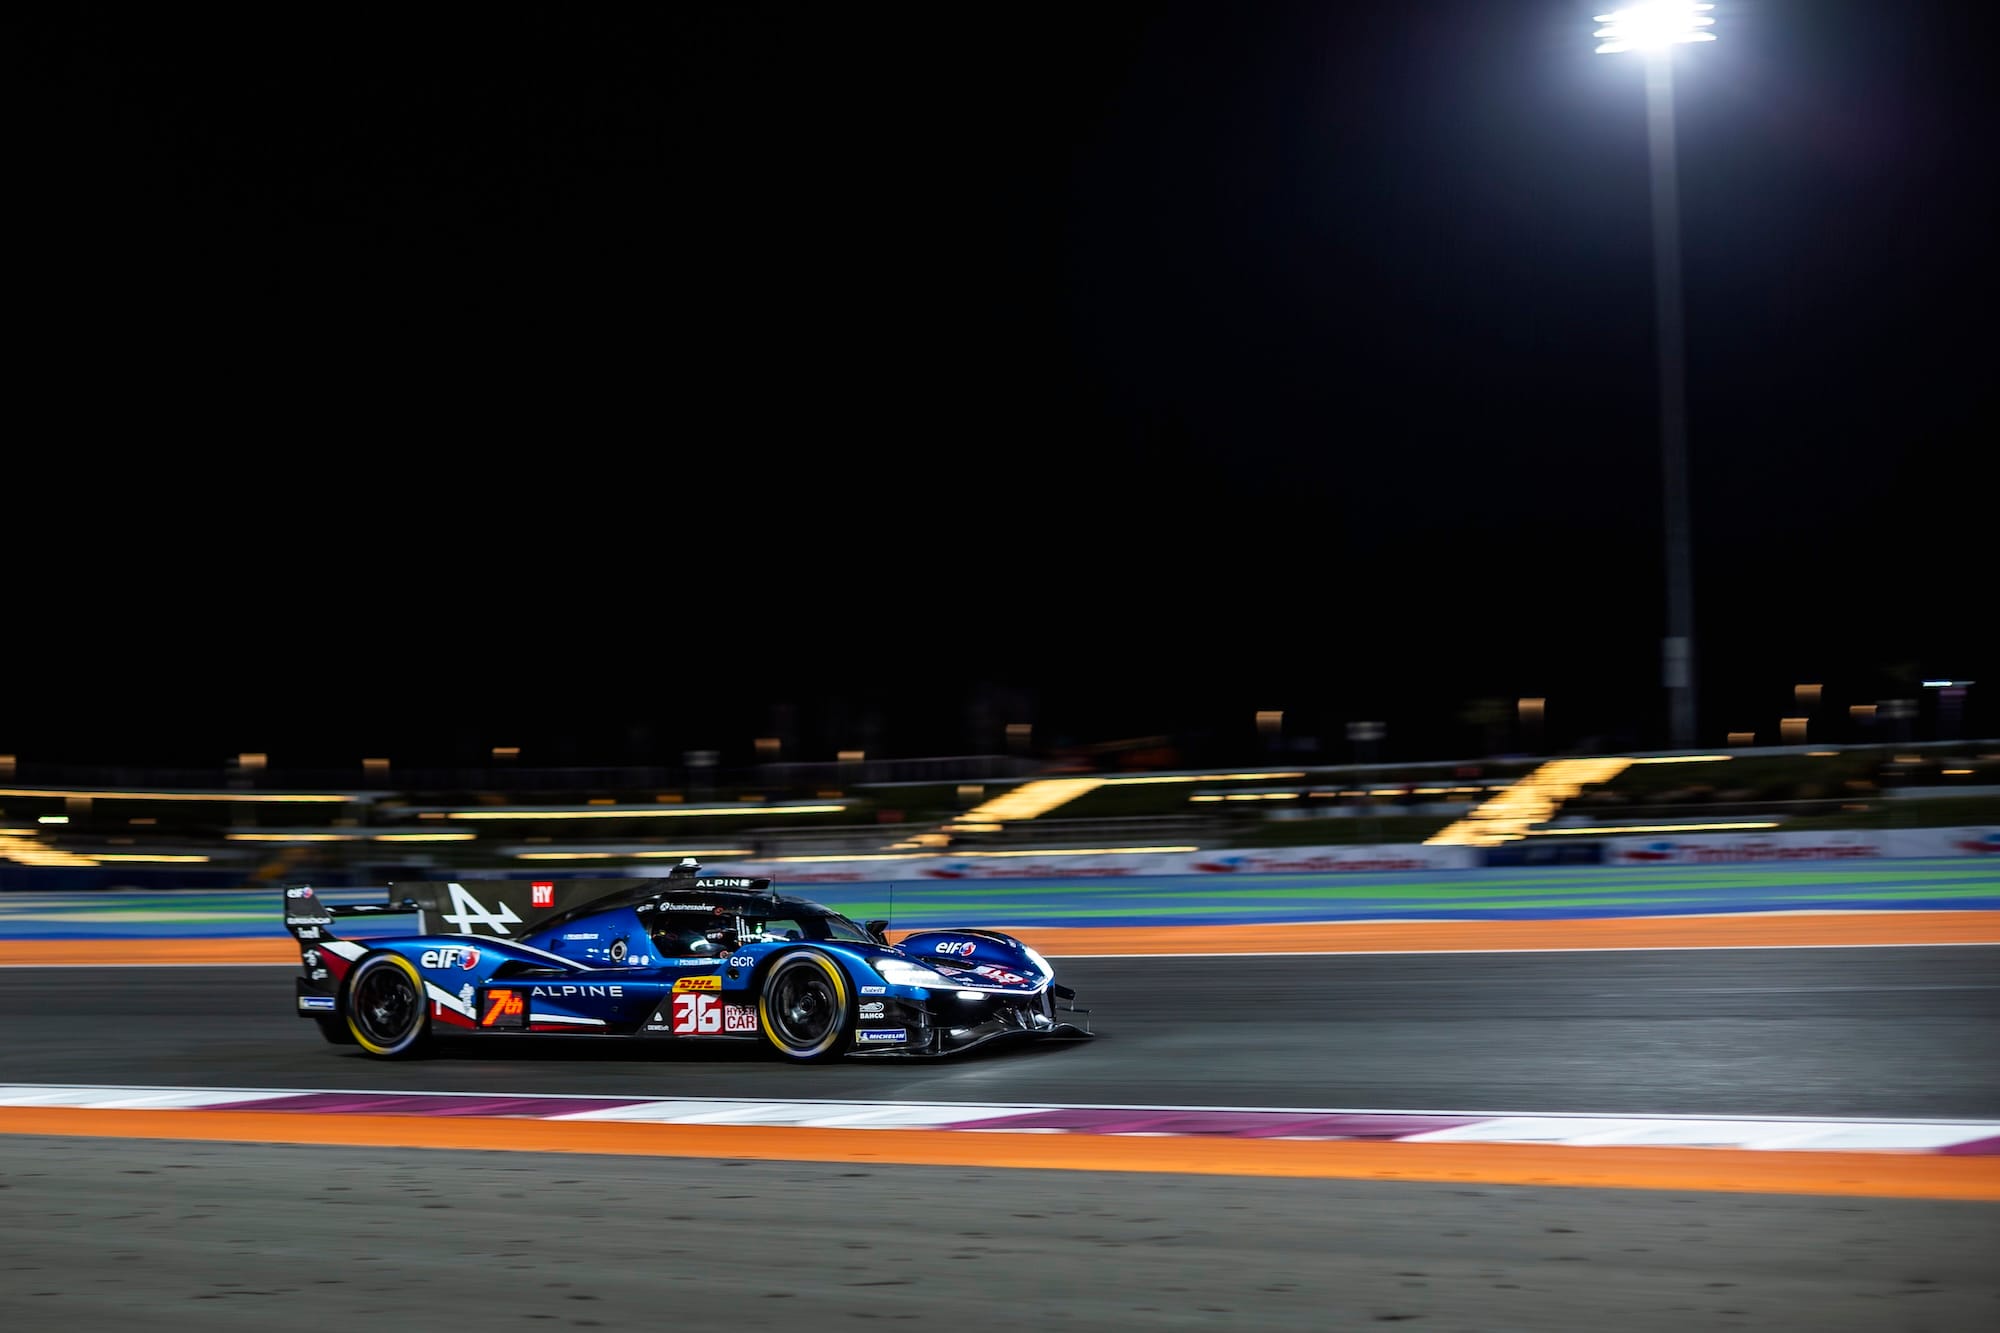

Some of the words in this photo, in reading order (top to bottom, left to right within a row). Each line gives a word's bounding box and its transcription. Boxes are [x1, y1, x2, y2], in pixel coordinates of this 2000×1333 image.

[696, 879, 750, 887] ALPINE
[532, 886, 552, 903] HY
[936, 942, 960, 954] elf
[421, 949, 457, 969] elf
[531, 985, 623, 997] ALPINE
[679, 980, 714, 988] DHL
[482, 989, 523, 1026] 7th
[673, 994, 721, 1032] 36
[727, 1015, 755, 1029] CAR
